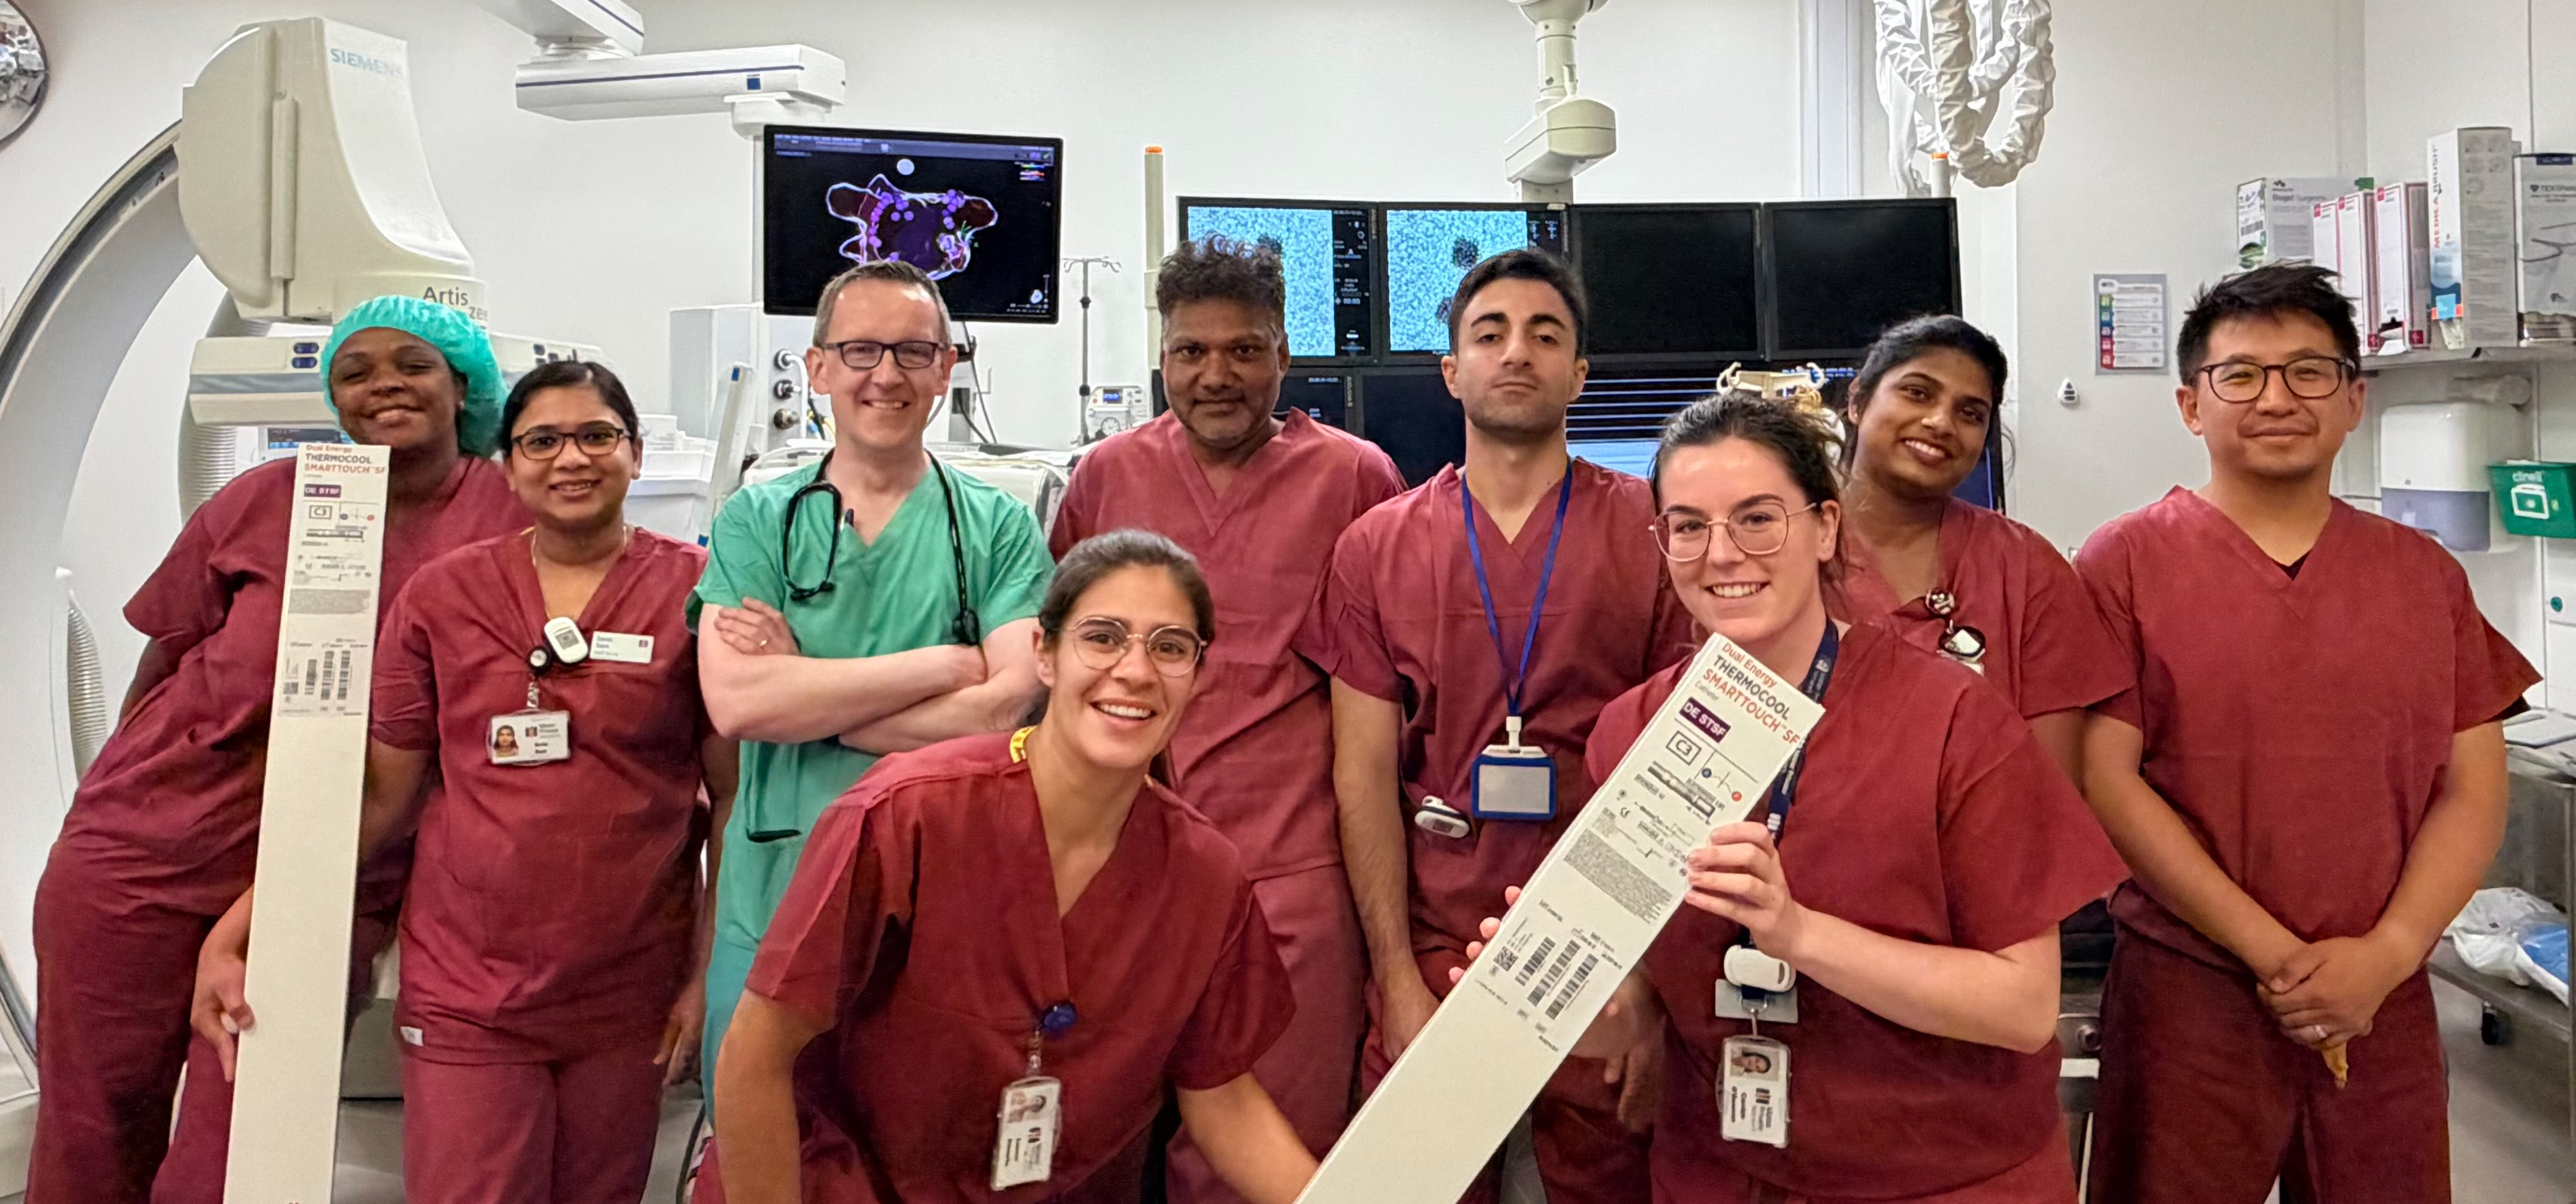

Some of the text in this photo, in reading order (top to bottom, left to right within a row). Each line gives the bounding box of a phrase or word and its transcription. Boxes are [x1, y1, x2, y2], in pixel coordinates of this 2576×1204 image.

[423, 286, 469, 306] Artis
[305, 453, 372, 464] THERMOCOOL
[326, 445, 353, 453] Energy
[1722, 642, 1777, 688] Dual Energy
[1713, 654, 1791, 721] THERMOCOOL
[1683, 702, 1727, 738] DE STSF
[1782, 729, 1801, 745] SF
[1675, 738, 1693, 756] C3
